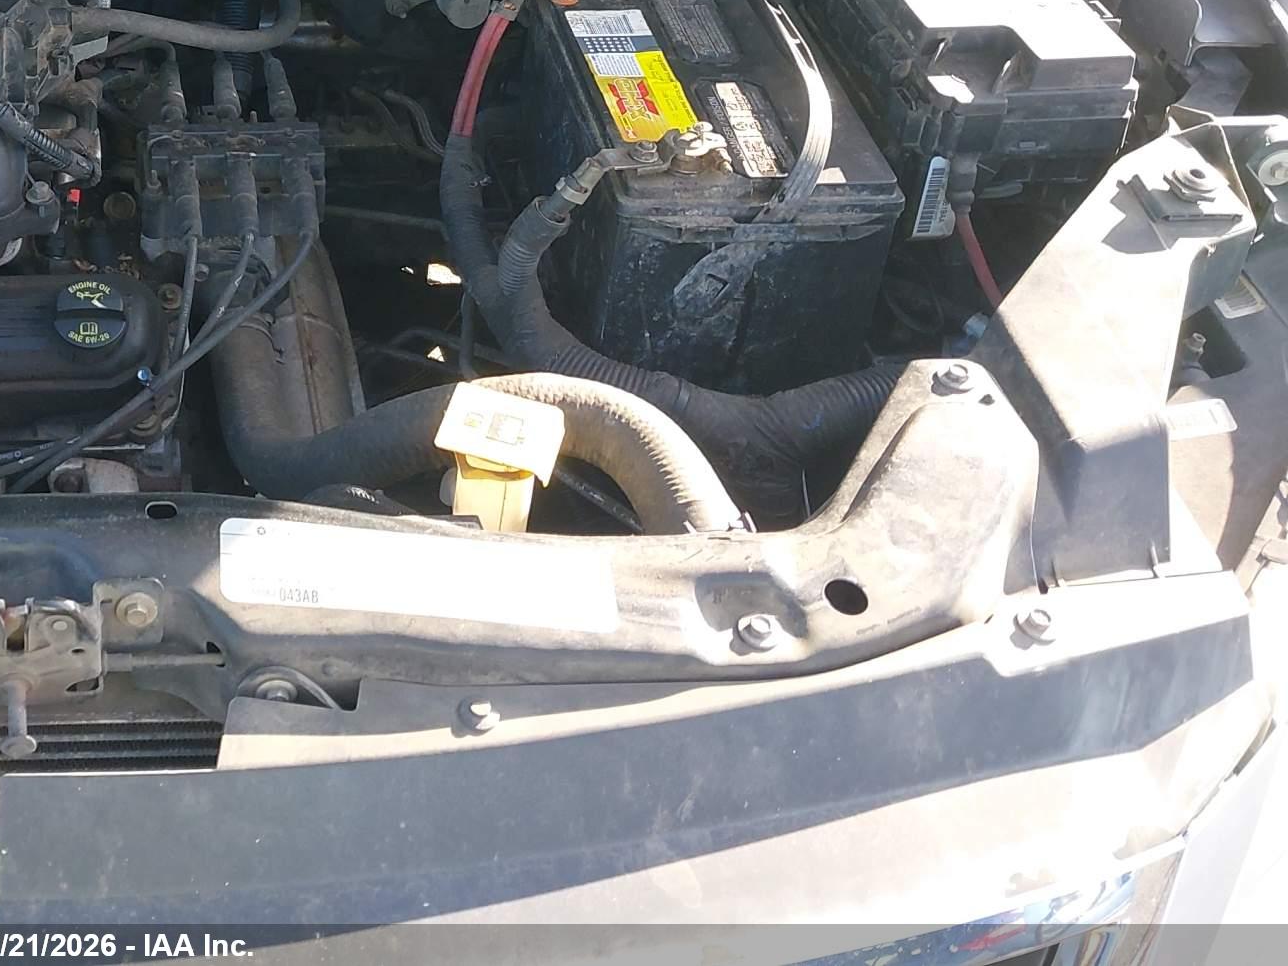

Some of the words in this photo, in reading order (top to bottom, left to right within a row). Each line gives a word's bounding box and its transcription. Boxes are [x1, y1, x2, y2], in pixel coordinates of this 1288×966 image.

[67, 281, 98, 294] ENGINE
[98, 283, 111, 295] OIL
[67, 331, 83, 343] SAE
